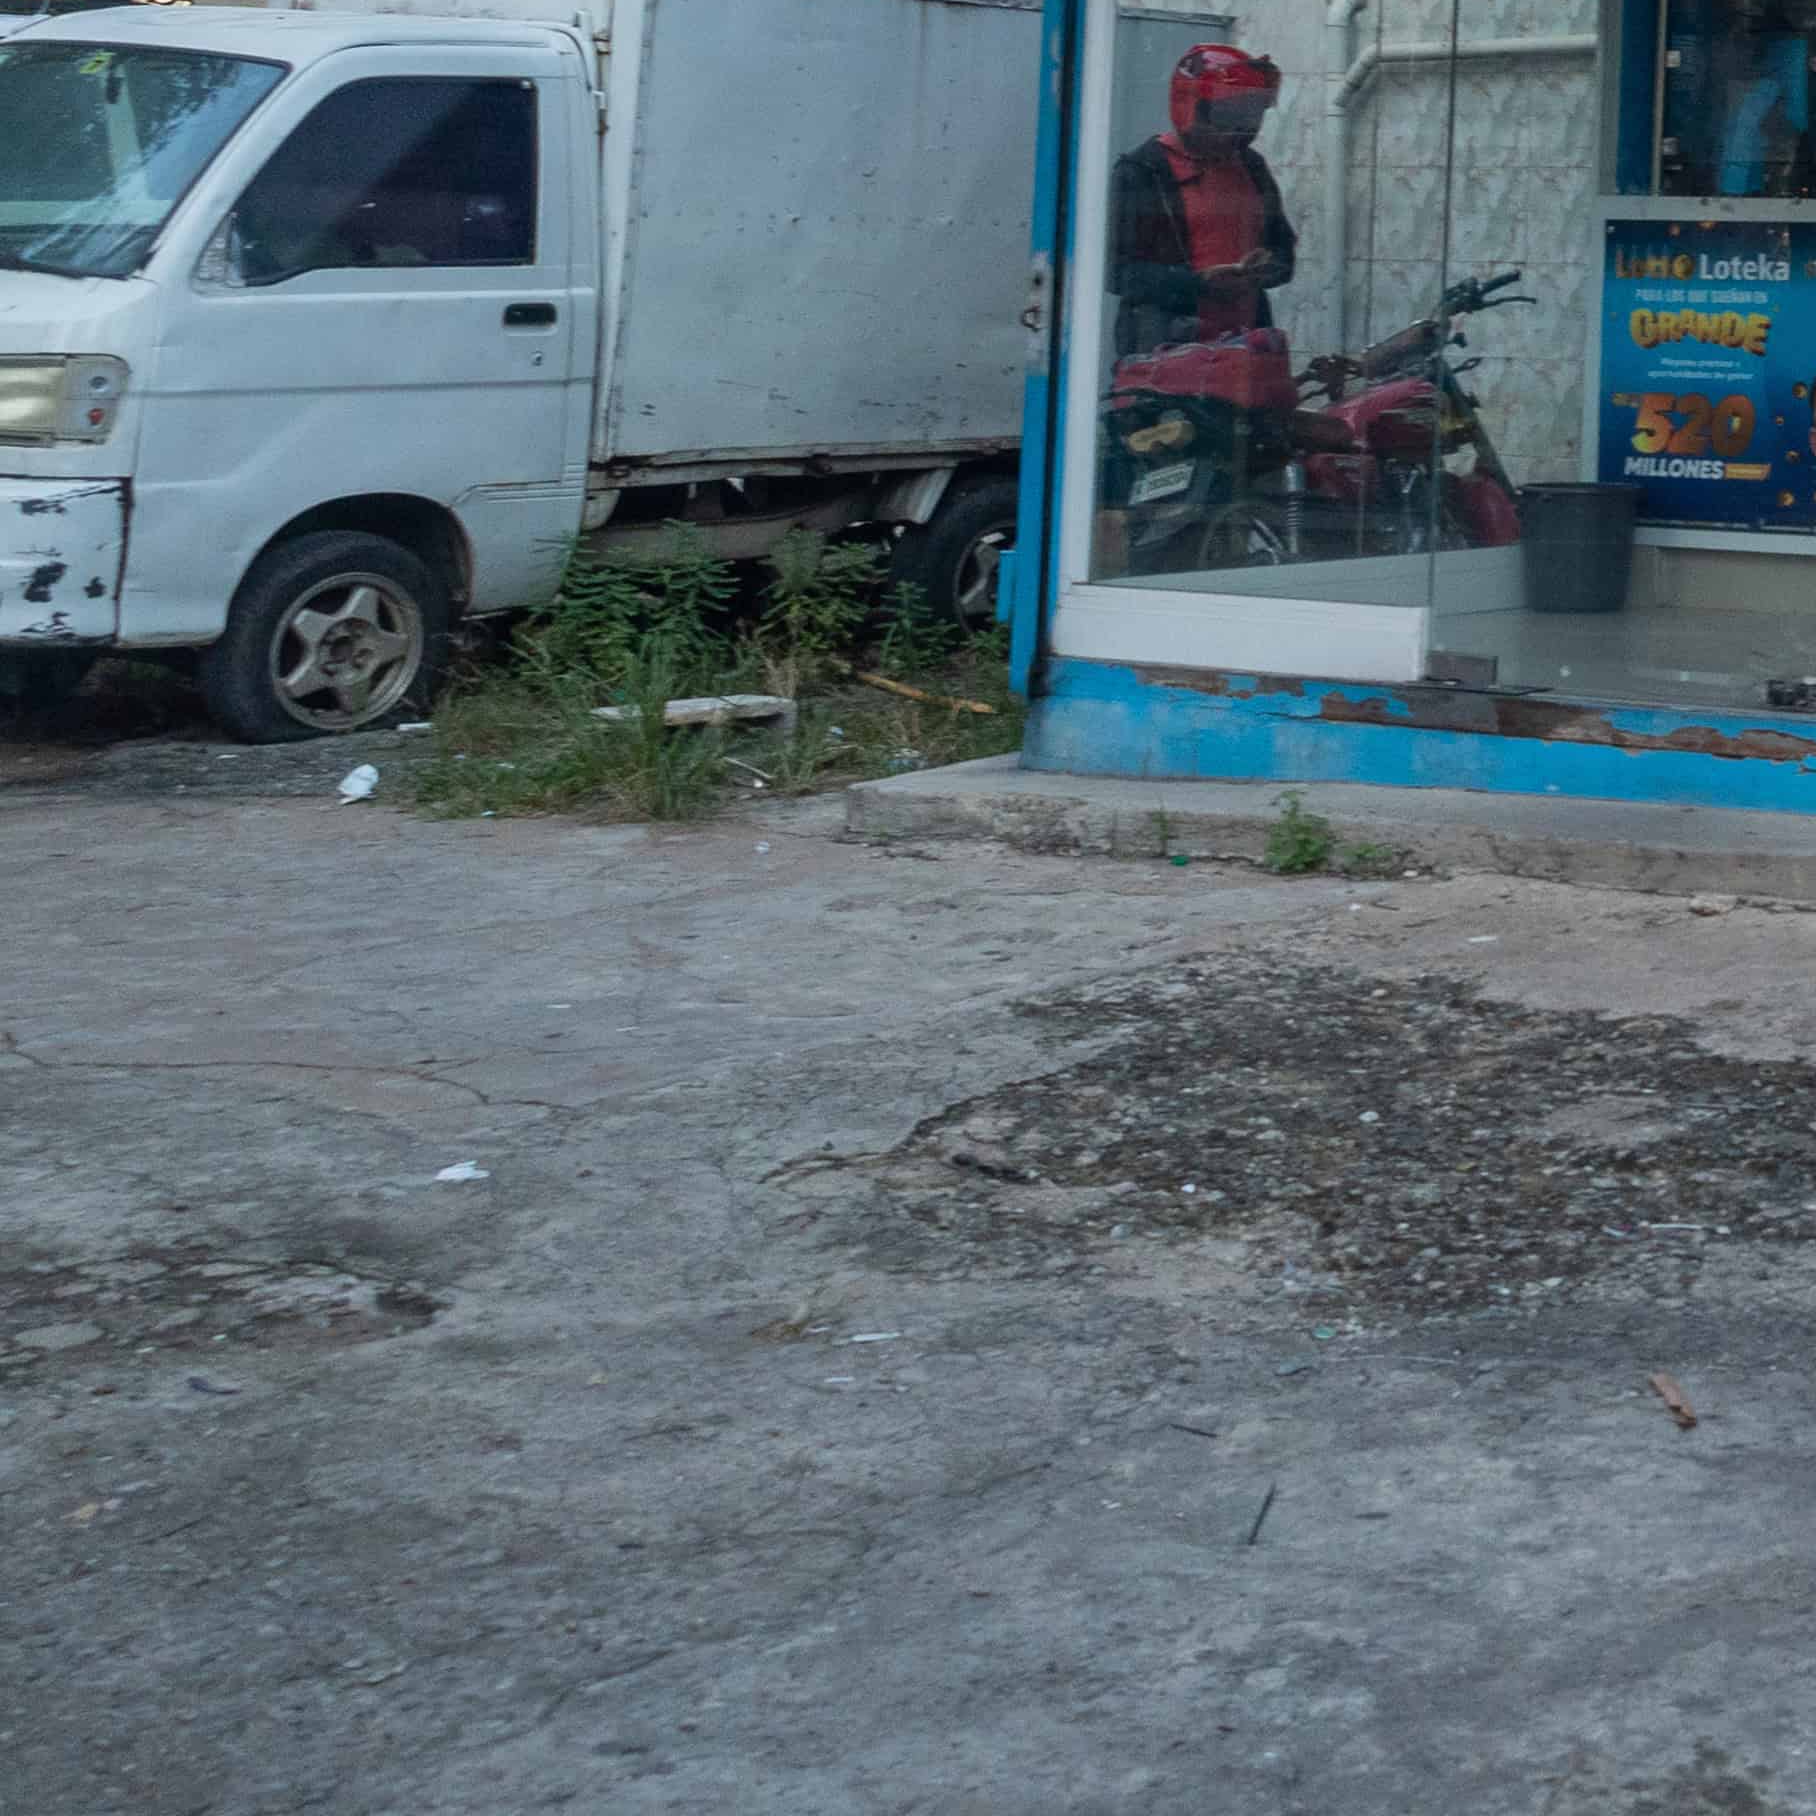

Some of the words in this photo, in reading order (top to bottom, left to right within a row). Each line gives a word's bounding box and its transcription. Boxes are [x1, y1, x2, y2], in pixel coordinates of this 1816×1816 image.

[1699, 252, 1790, 282] Loteka
[1629, 308, 1771, 356] GRANDE
[1631, 391, 1756, 457] 520
[1624, 456, 1726, 482] MILLONES
